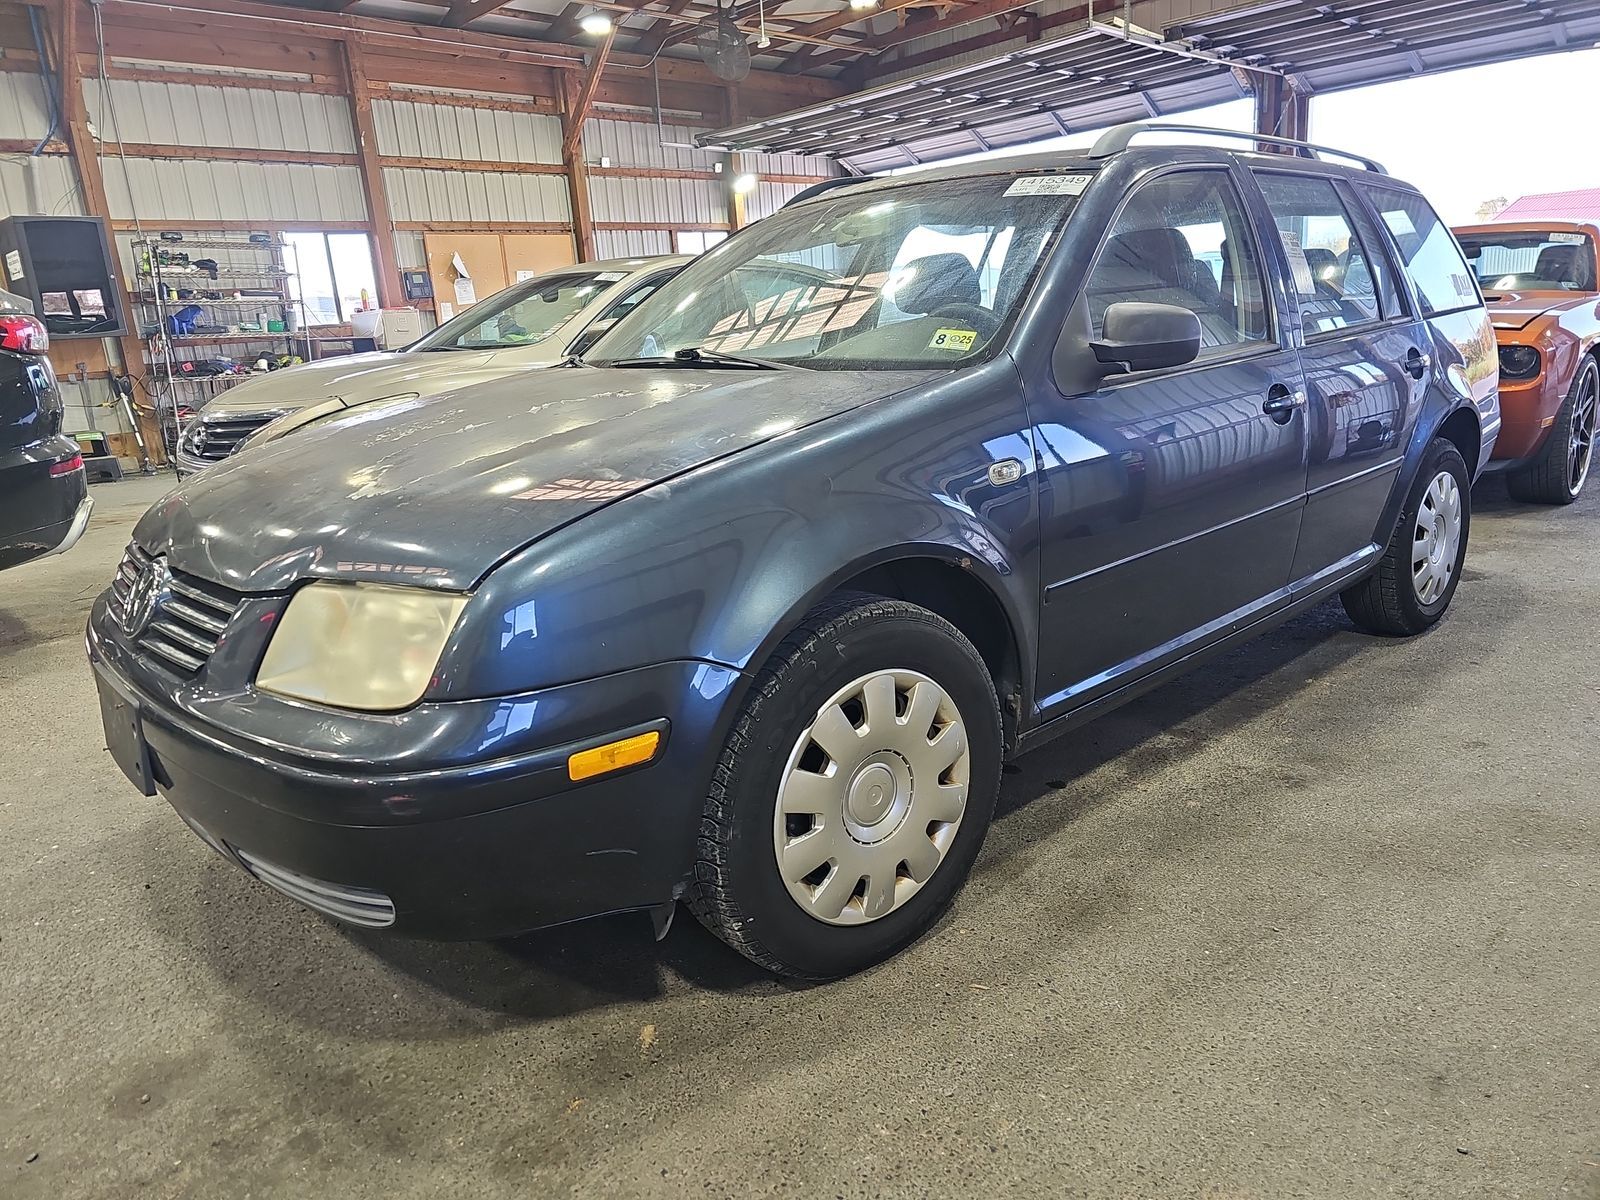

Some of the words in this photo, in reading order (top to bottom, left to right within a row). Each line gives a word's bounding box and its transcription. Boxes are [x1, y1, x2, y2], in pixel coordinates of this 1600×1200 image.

[1020, 176, 1087, 185] 1415349
[935, 334, 947, 345] 8
[959, 335, 973, 344] 25
